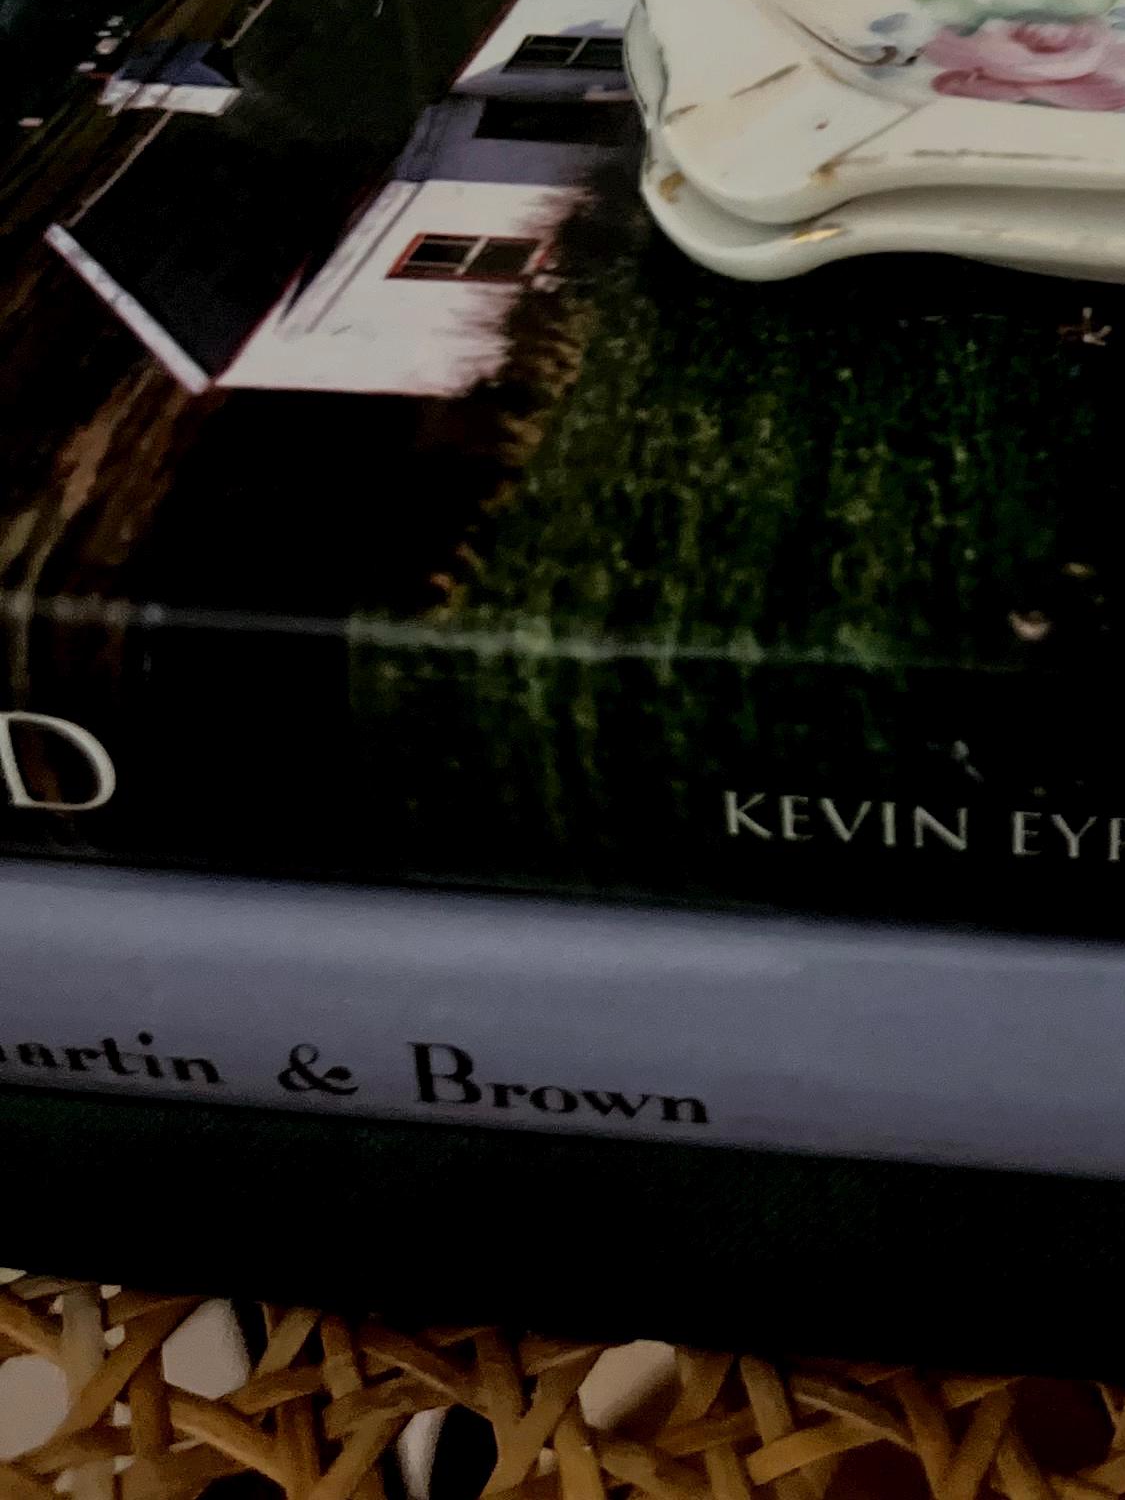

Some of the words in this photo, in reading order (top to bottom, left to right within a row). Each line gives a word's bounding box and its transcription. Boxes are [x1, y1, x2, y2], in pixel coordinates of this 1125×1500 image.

[725, 790, 969, 851] KEVIN
[0, 1031, 220, 1083] artin
[277, 1042, 361, 1097] &
[407, 1041, 711, 1126] Brown
